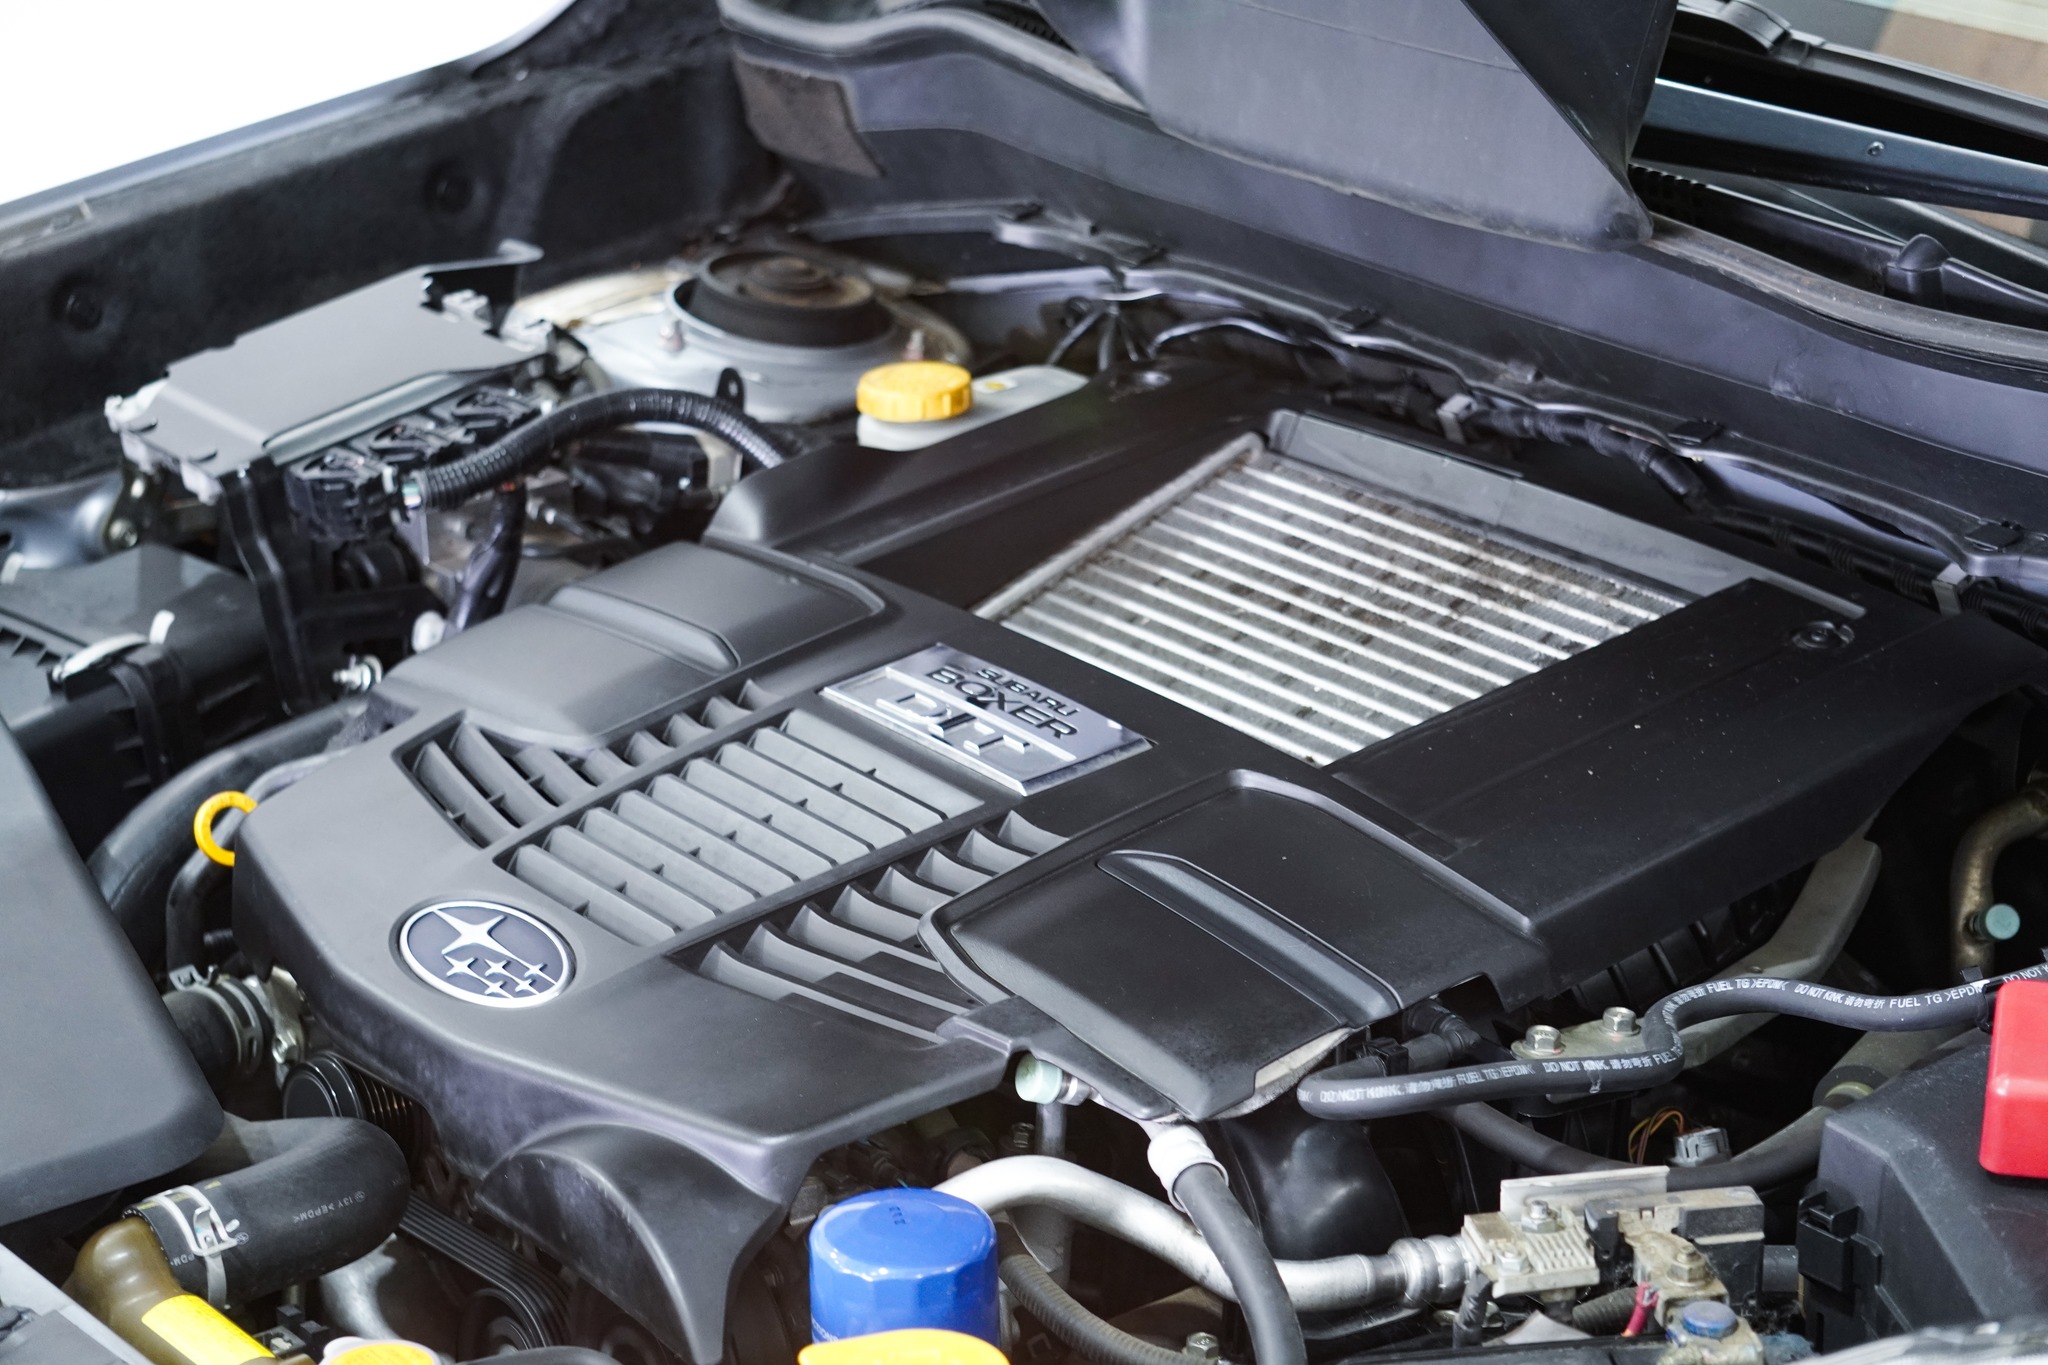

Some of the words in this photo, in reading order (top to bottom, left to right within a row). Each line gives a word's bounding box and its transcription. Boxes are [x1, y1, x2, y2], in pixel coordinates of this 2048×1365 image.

[925, 665, 1078, 740] BOXER
[976, 667, 1080, 717] SUBARU
[876, 692, 1031, 757] DIT
[1706, 980, 1734, 993] FUEL
[1735, 979, 1750, 988] TG
[1794, 983, 1809, 994] DO
[1808, 986, 1825, 998] NOT
[1889, 997, 1921, 1009] FUEL
[1925, 993, 1943, 1006] TG
[2020, 967, 2043, 980] NOT
[1457, 1072, 1484, 1086] FUEL
[1543, 1062, 1559, 1073] DO
[1561, 1060, 1581, 1072] NOT
[1653, 1050, 1676, 1064] FUEL
